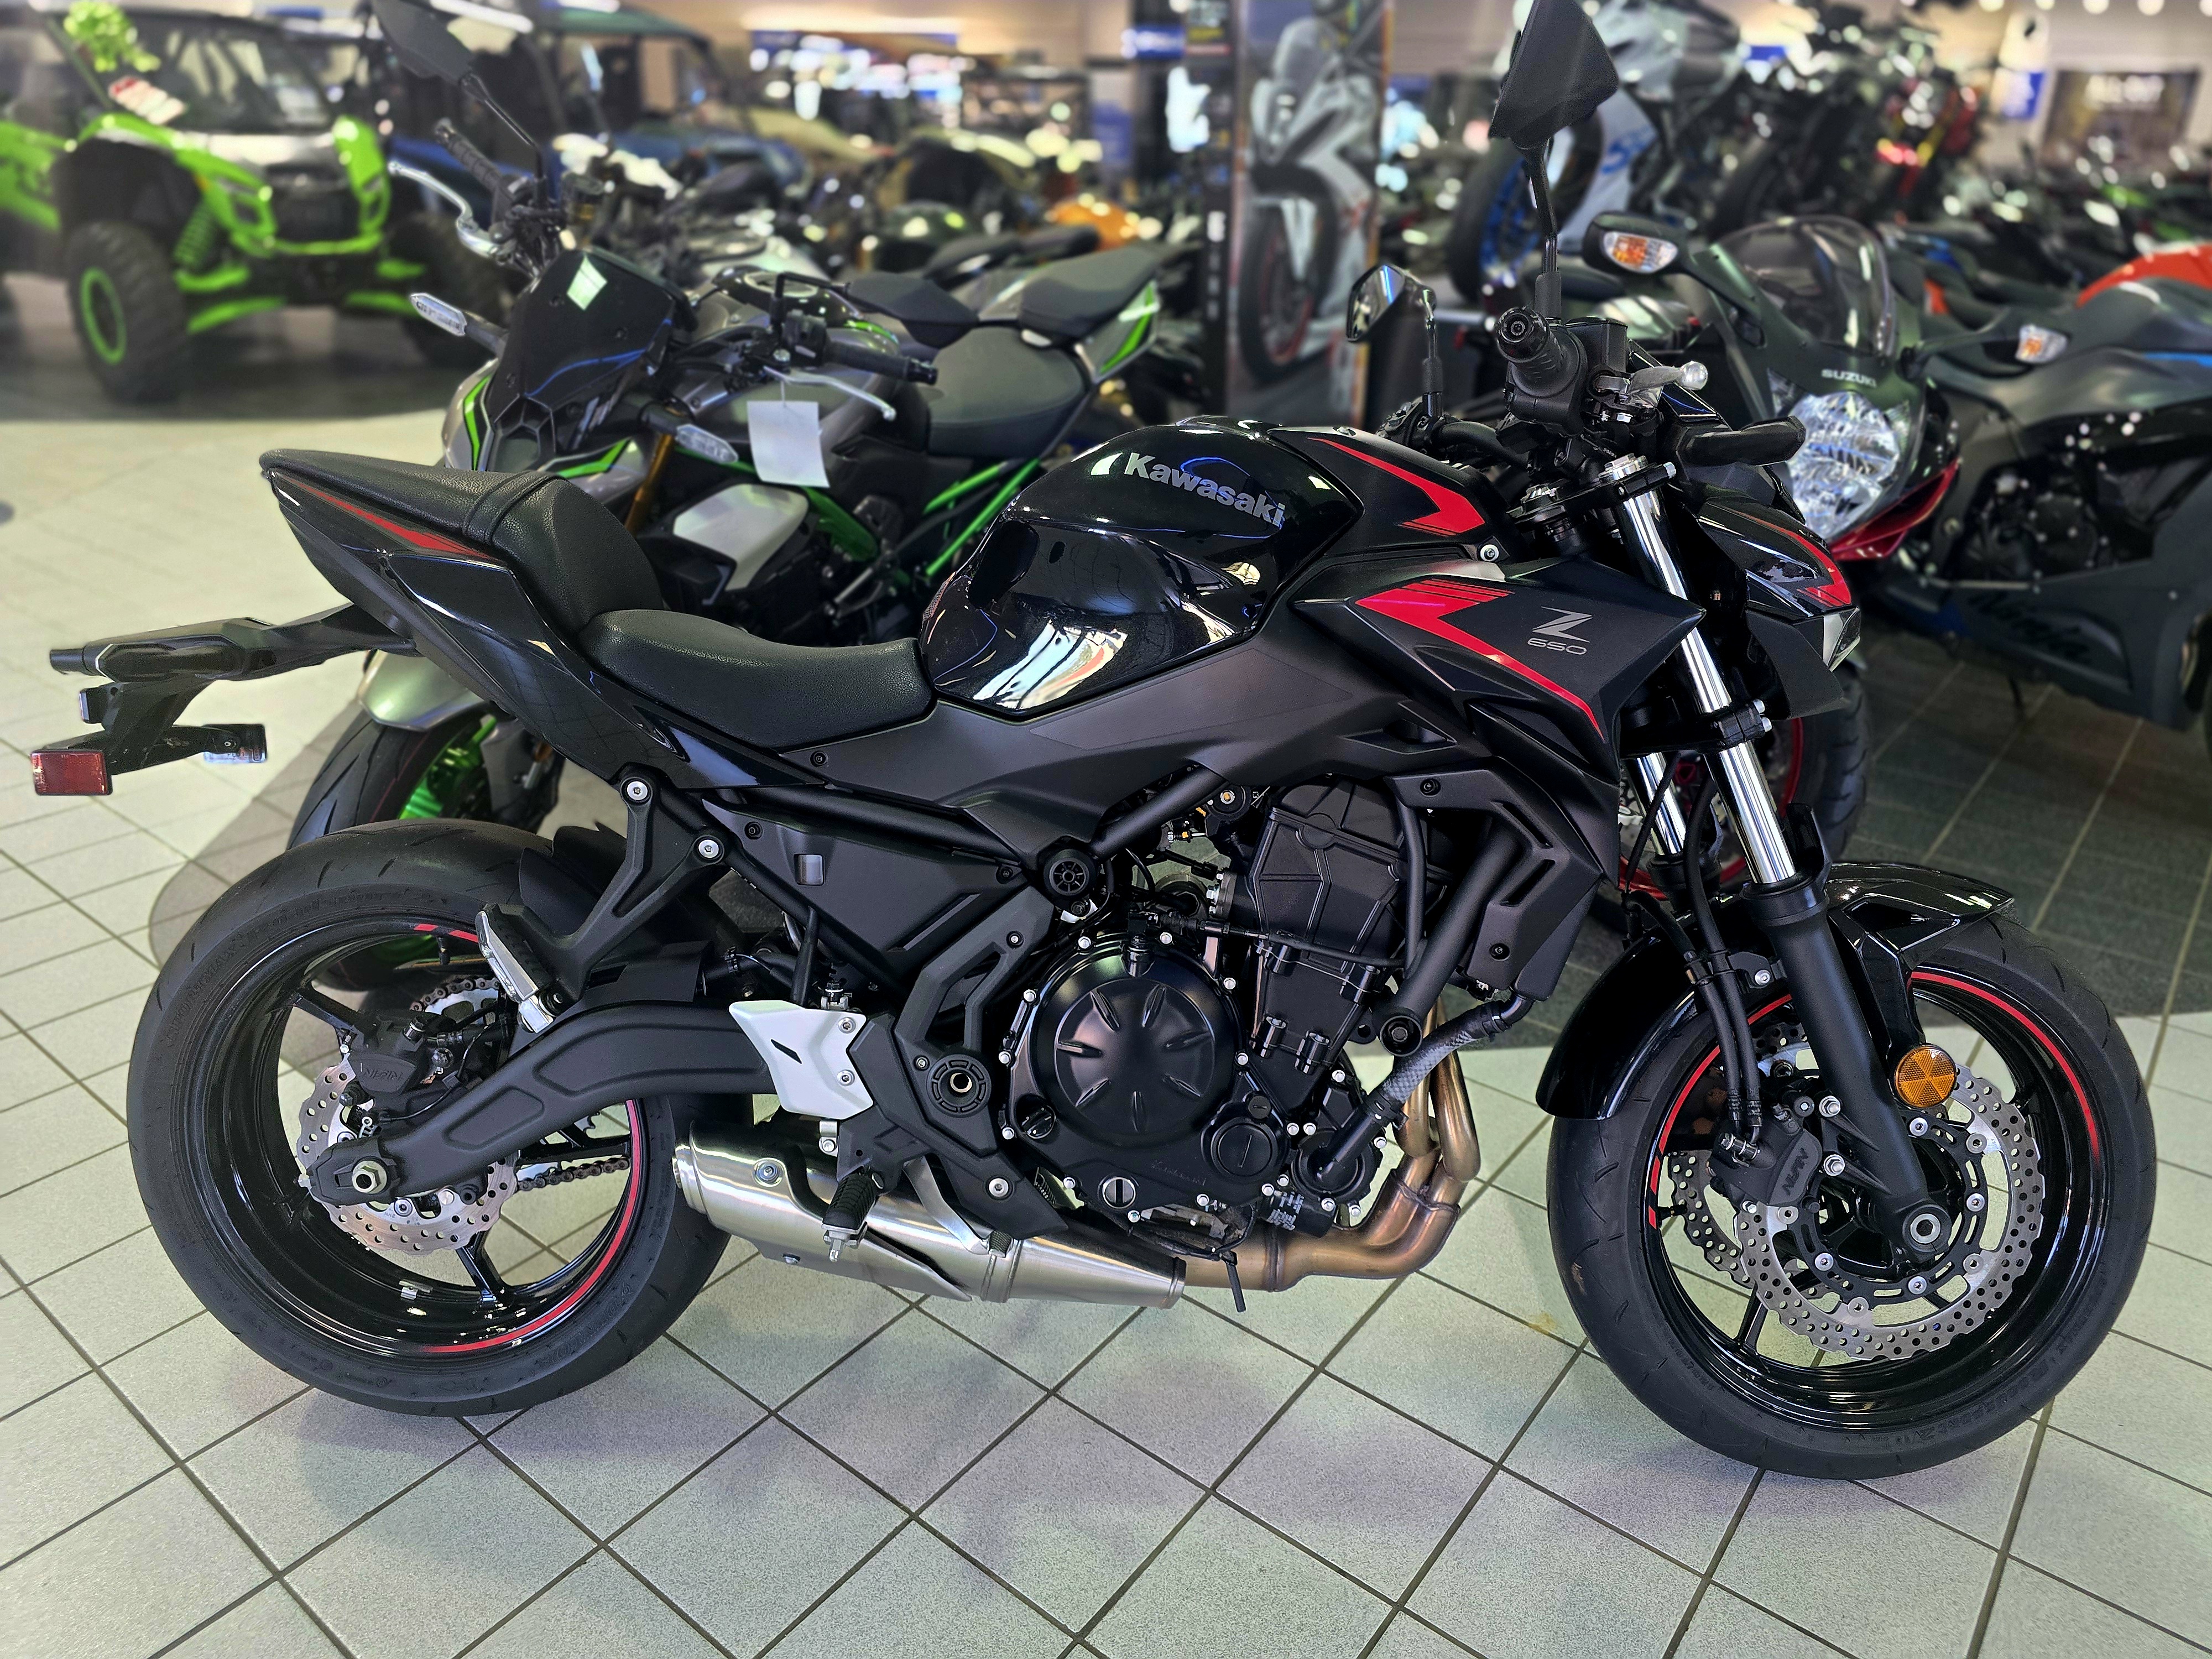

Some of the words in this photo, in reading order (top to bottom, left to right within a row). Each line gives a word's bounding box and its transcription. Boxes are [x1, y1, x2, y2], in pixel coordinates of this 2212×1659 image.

[1822, 368, 1876, 388] SUZUKI
[1124, 452, 1285, 526] Kawasaki
[1532, 606, 1593, 643] Z
[1527, 638, 1587, 655] 650
